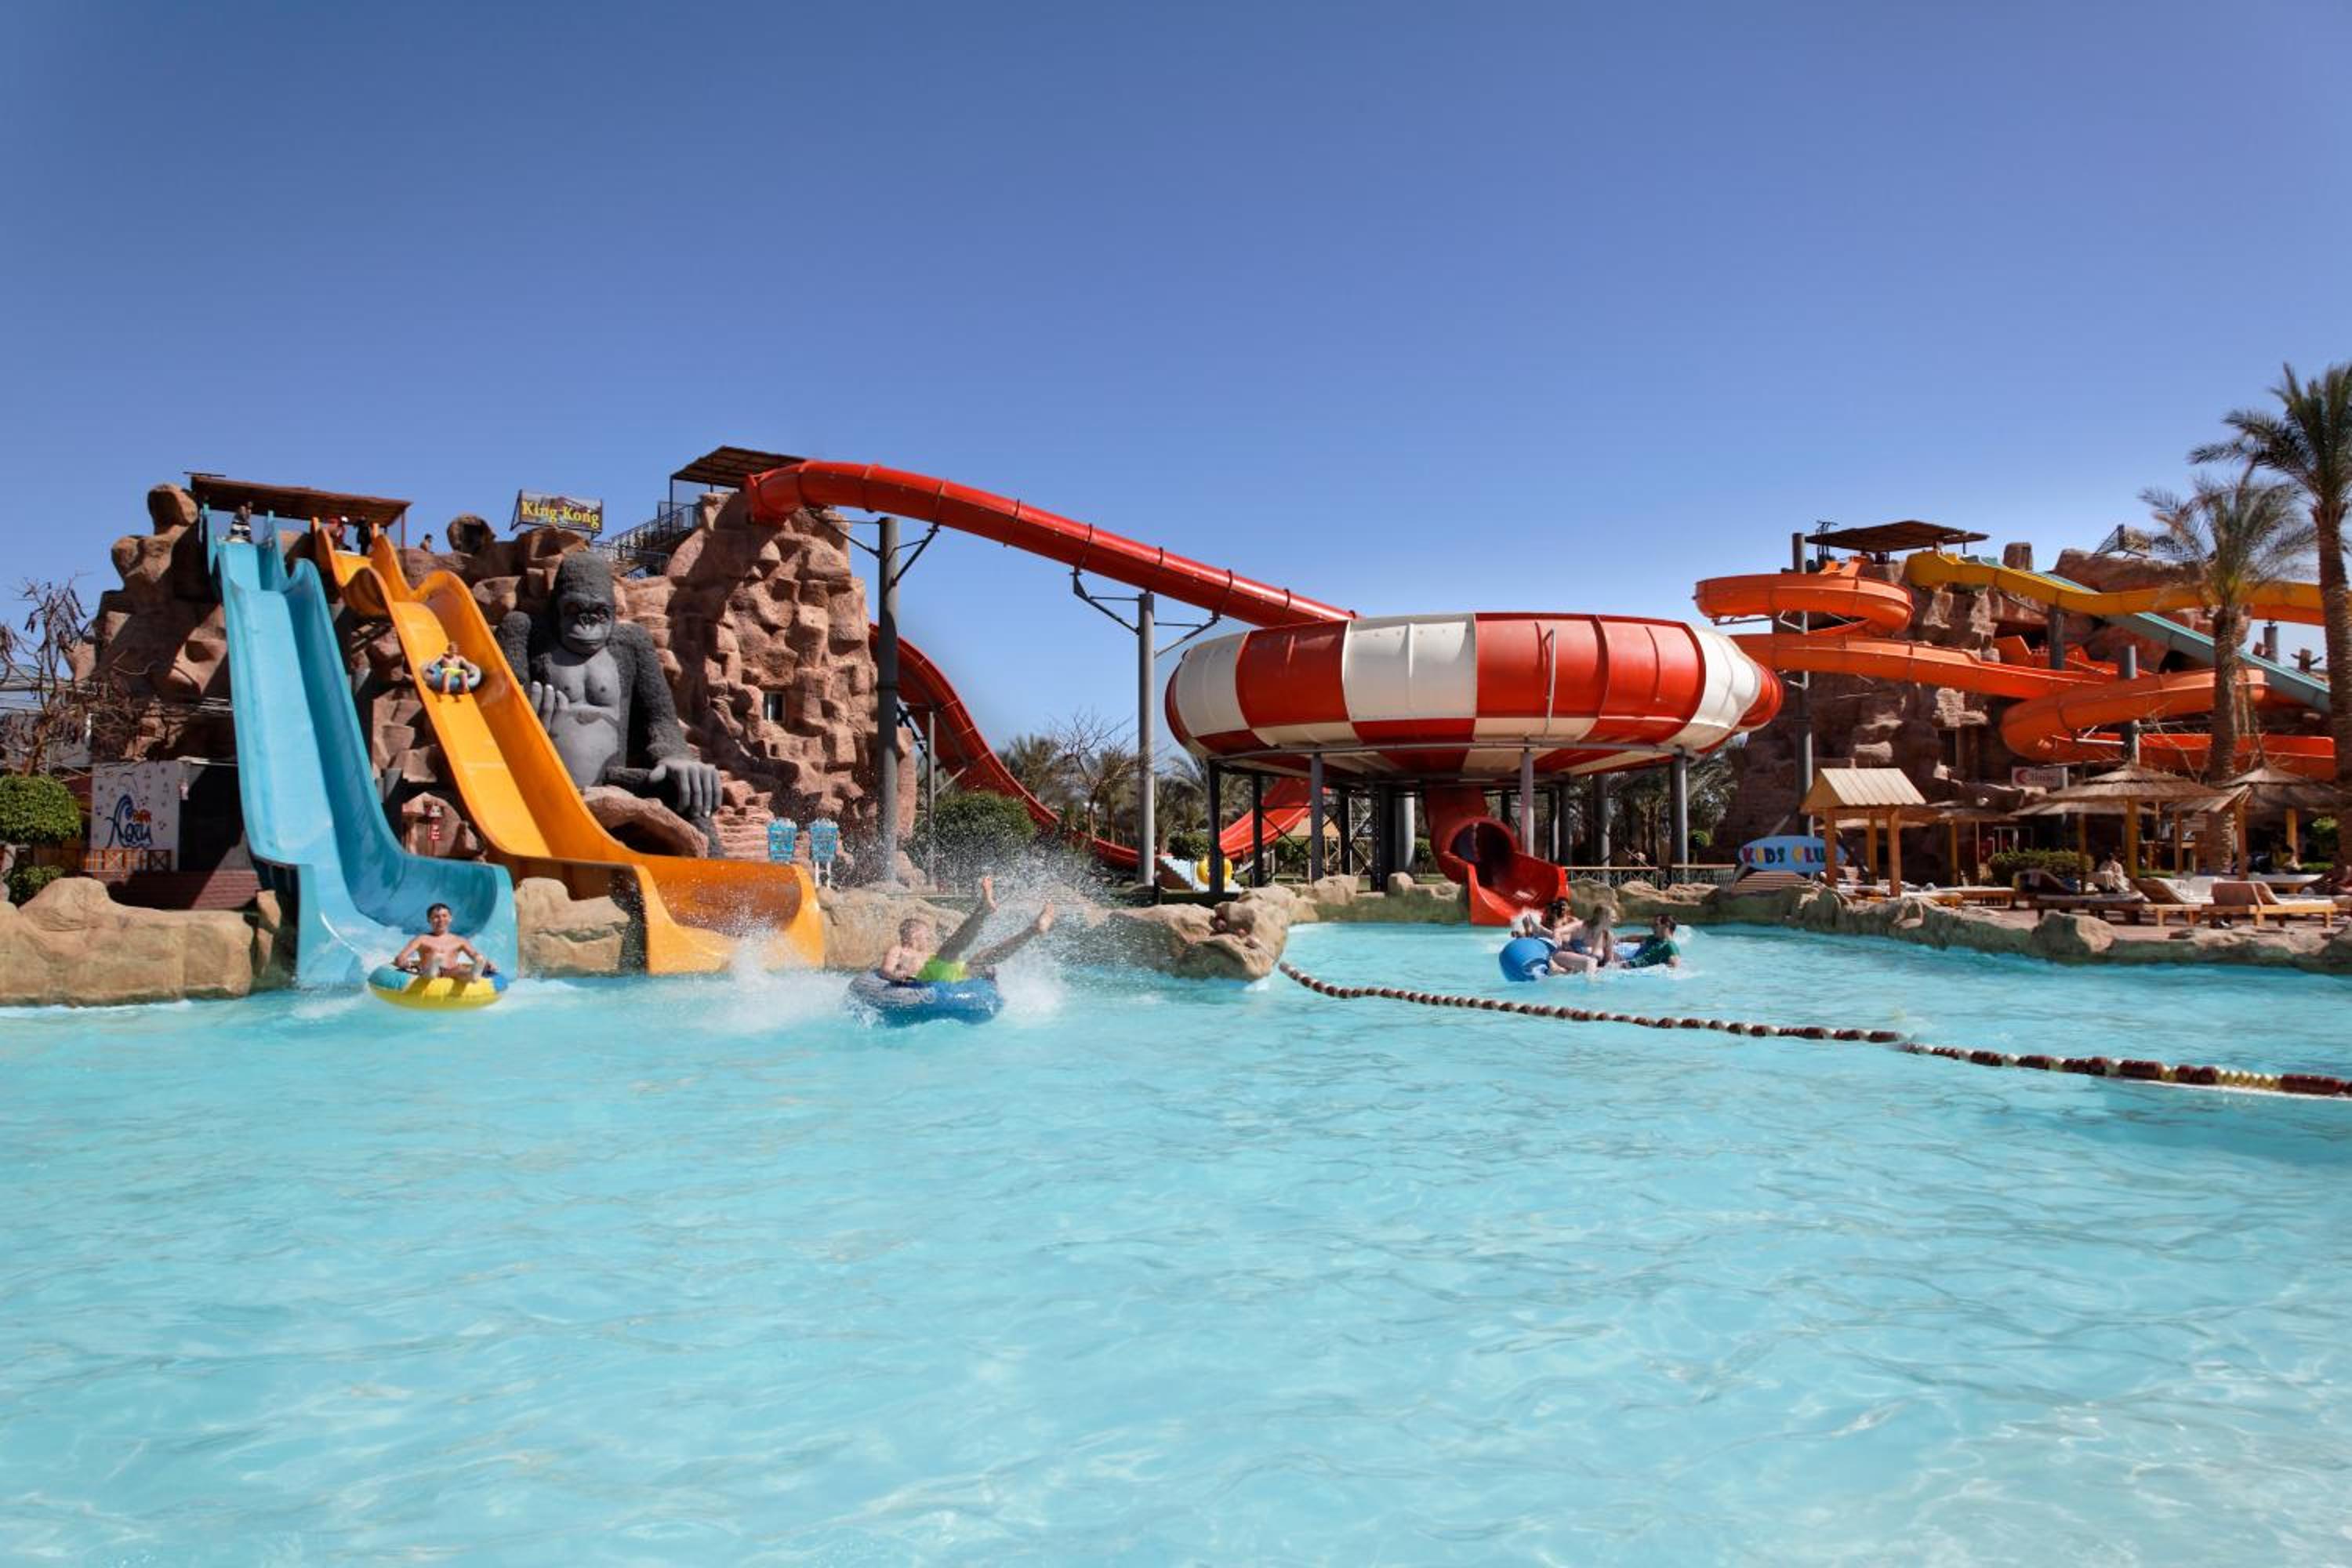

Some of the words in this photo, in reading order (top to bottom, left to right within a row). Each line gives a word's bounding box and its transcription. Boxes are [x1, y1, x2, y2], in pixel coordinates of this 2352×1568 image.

[522, 502, 557, 523] King
[564, 506, 599, 528] Kong
[1743, 847, 1785, 864] KIDS
[1792, 847, 1826, 864] CLU
